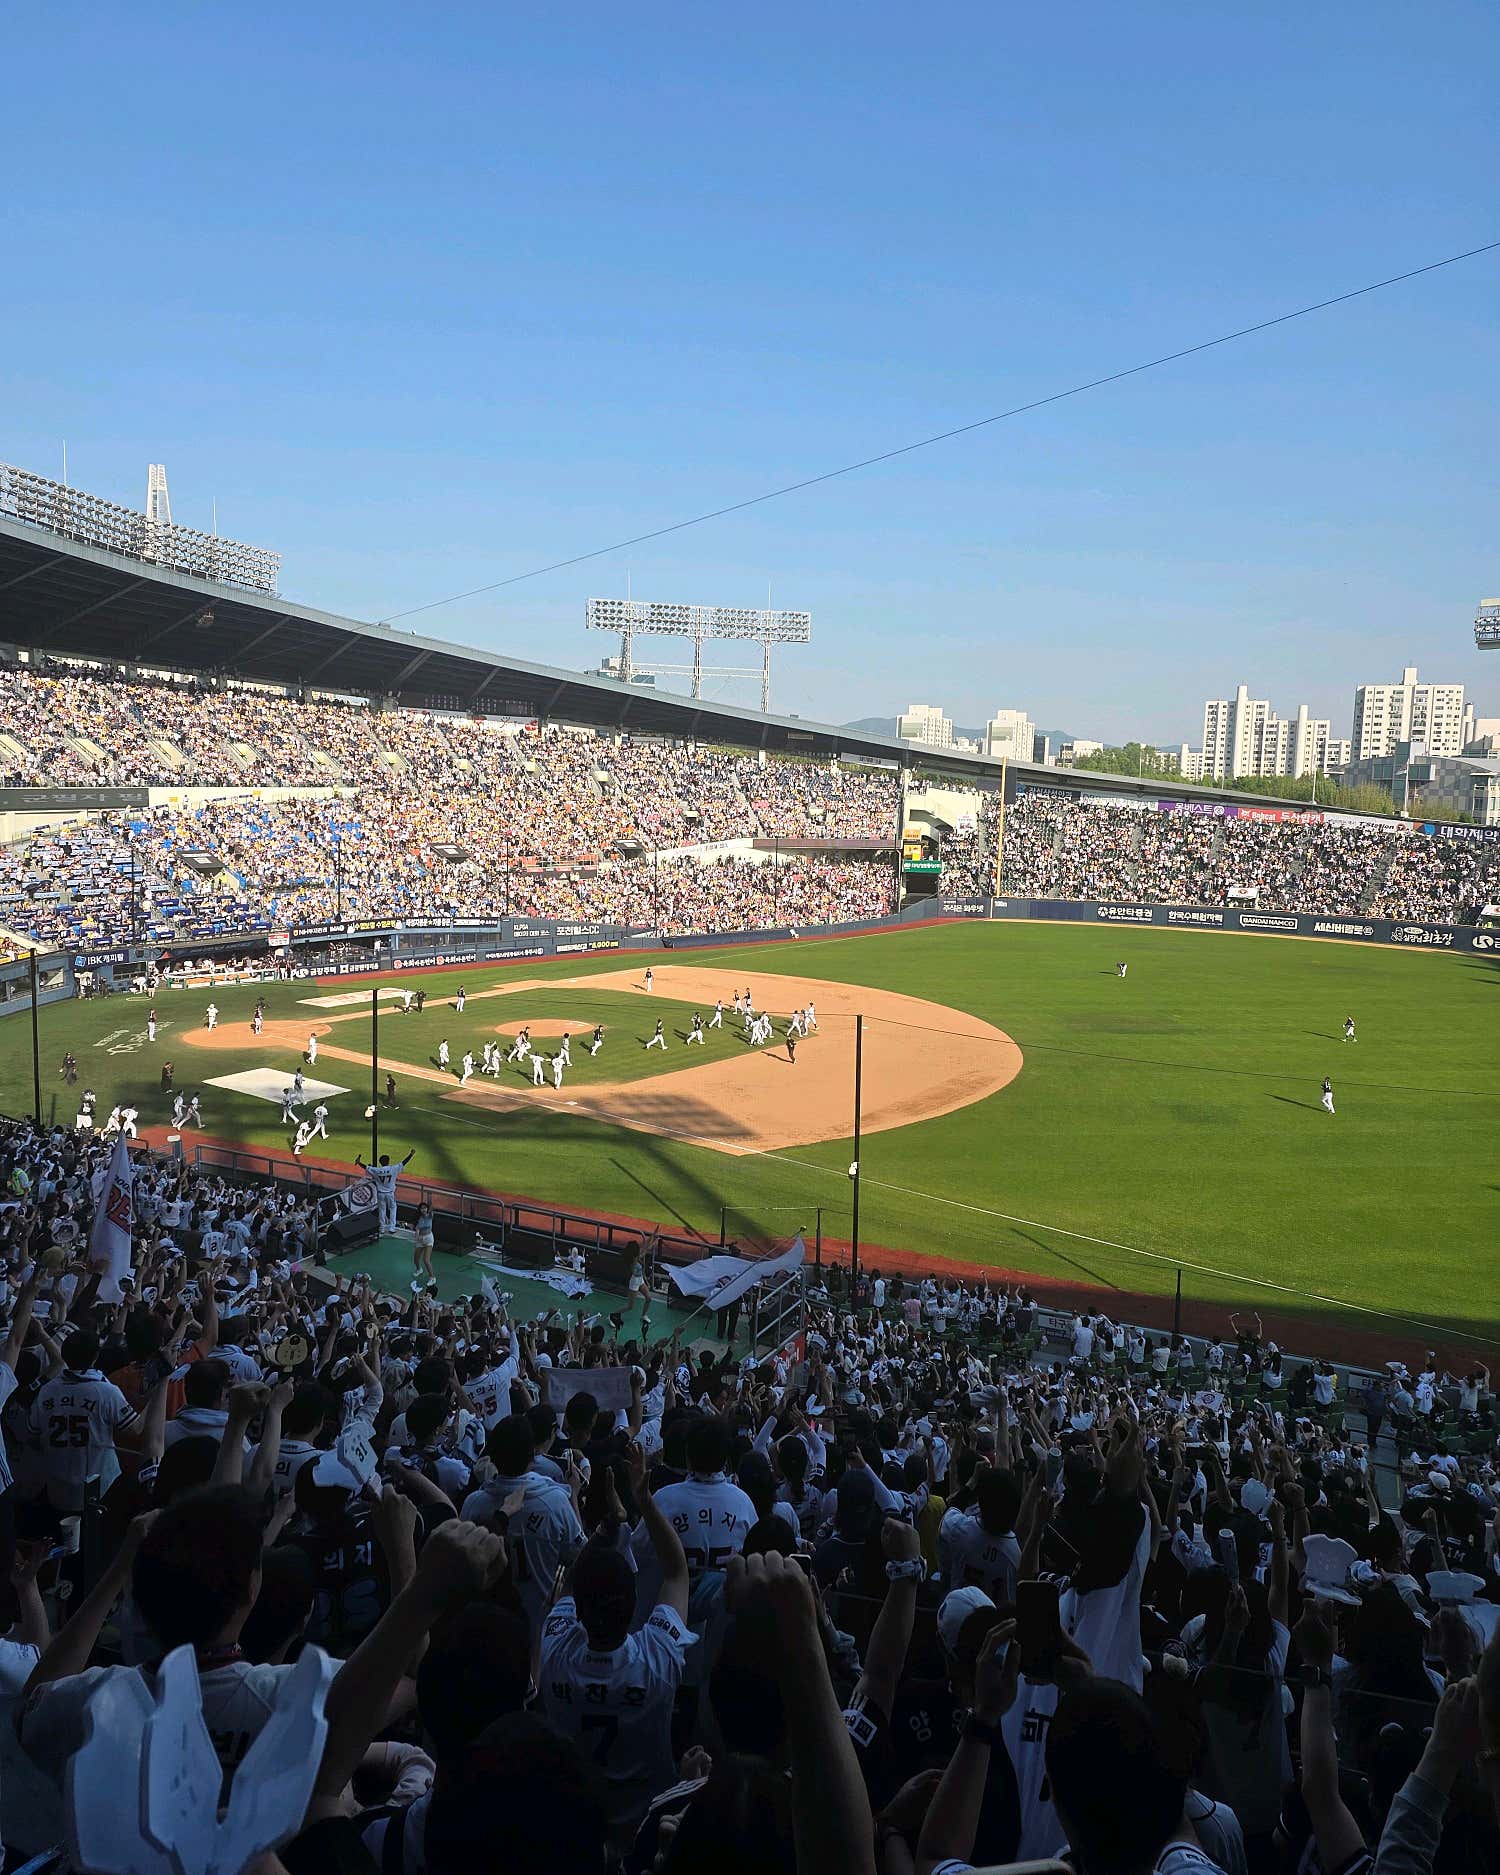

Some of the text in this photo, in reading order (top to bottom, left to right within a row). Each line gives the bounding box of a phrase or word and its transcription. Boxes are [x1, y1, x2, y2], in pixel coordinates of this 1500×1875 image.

[1250, 811, 1276, 820] Bobcat
[1440, 826, 1497, 841] 대화제약
[942, 904, 961, 912] 주식은
[1108, 906, 1153, 917] 유안타증권
[1168, 911, 1223, 922] 한국수력원자력
[1243, 917, 1268, 925] BANDAI
[1313, 922, 1363, 935] 세신버팔로
[1422, 931, 1454, 946] 회초장
[48, 1415, 89, 1448] 25
[355, 1442, 368, 1462] 31
[672, 1508, 737, 1534] 양의지
[582, 1715, 618, 1767] 7
